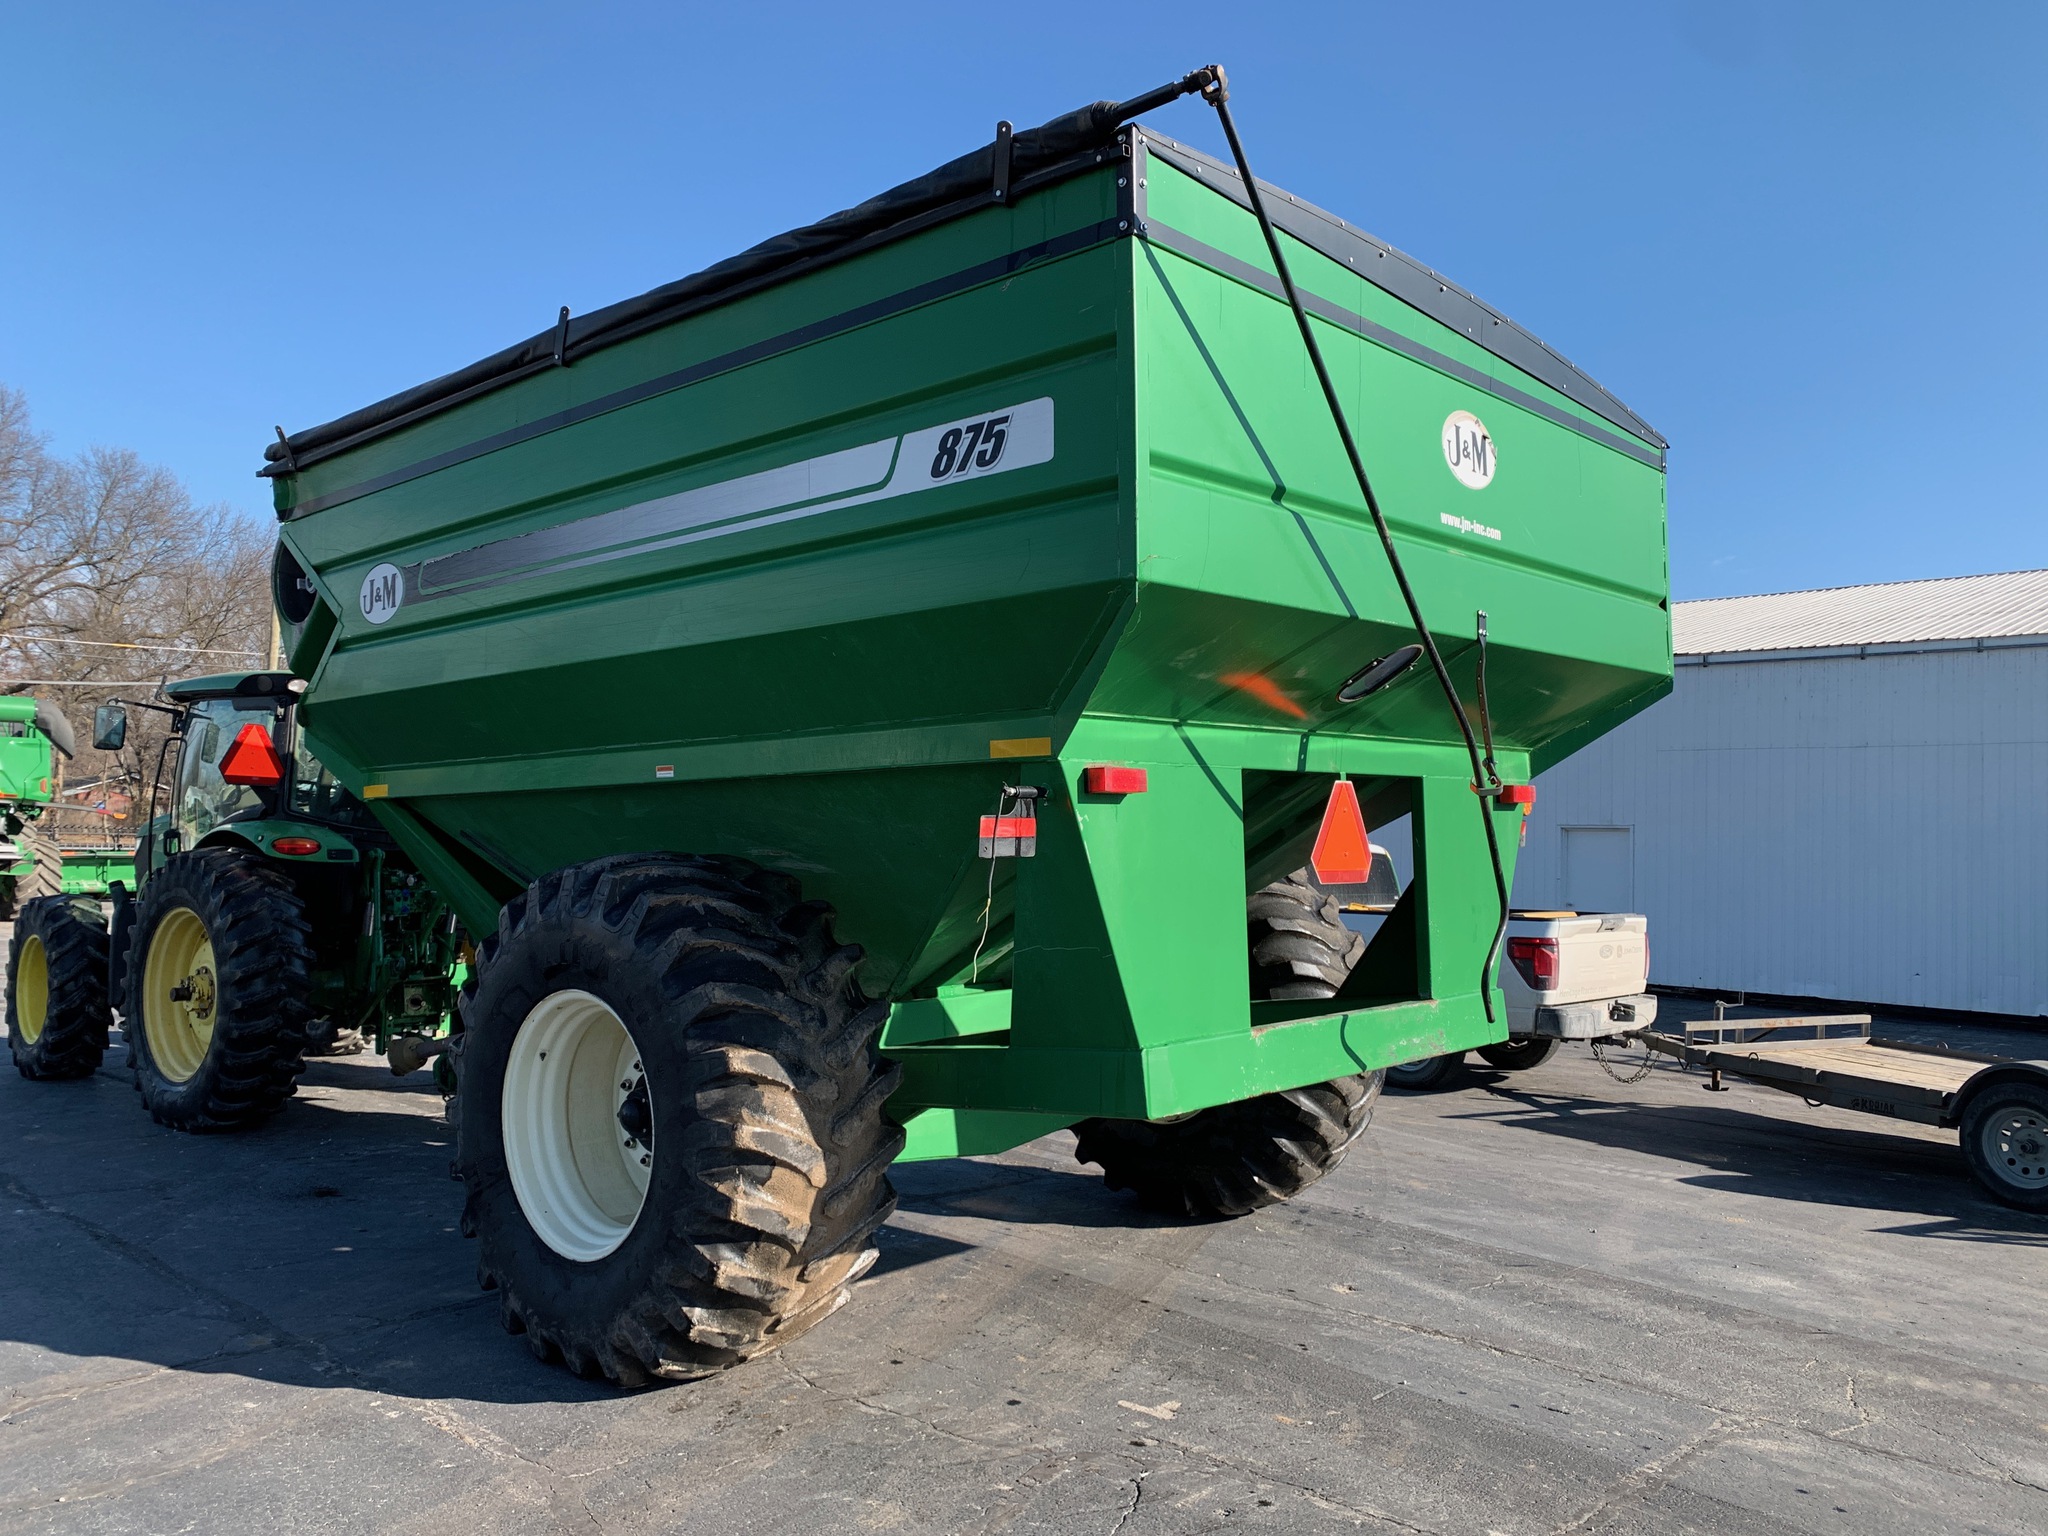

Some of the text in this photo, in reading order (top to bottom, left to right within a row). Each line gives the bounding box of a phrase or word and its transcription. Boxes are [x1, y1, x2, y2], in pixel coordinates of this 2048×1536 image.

[930, 413, 1013, 480] 875
[1446, 423, 1489, 477] J&M
[1440, 512, 1502, 541] www.jm-inc.com
[363, 573, 397, 615] J&M
